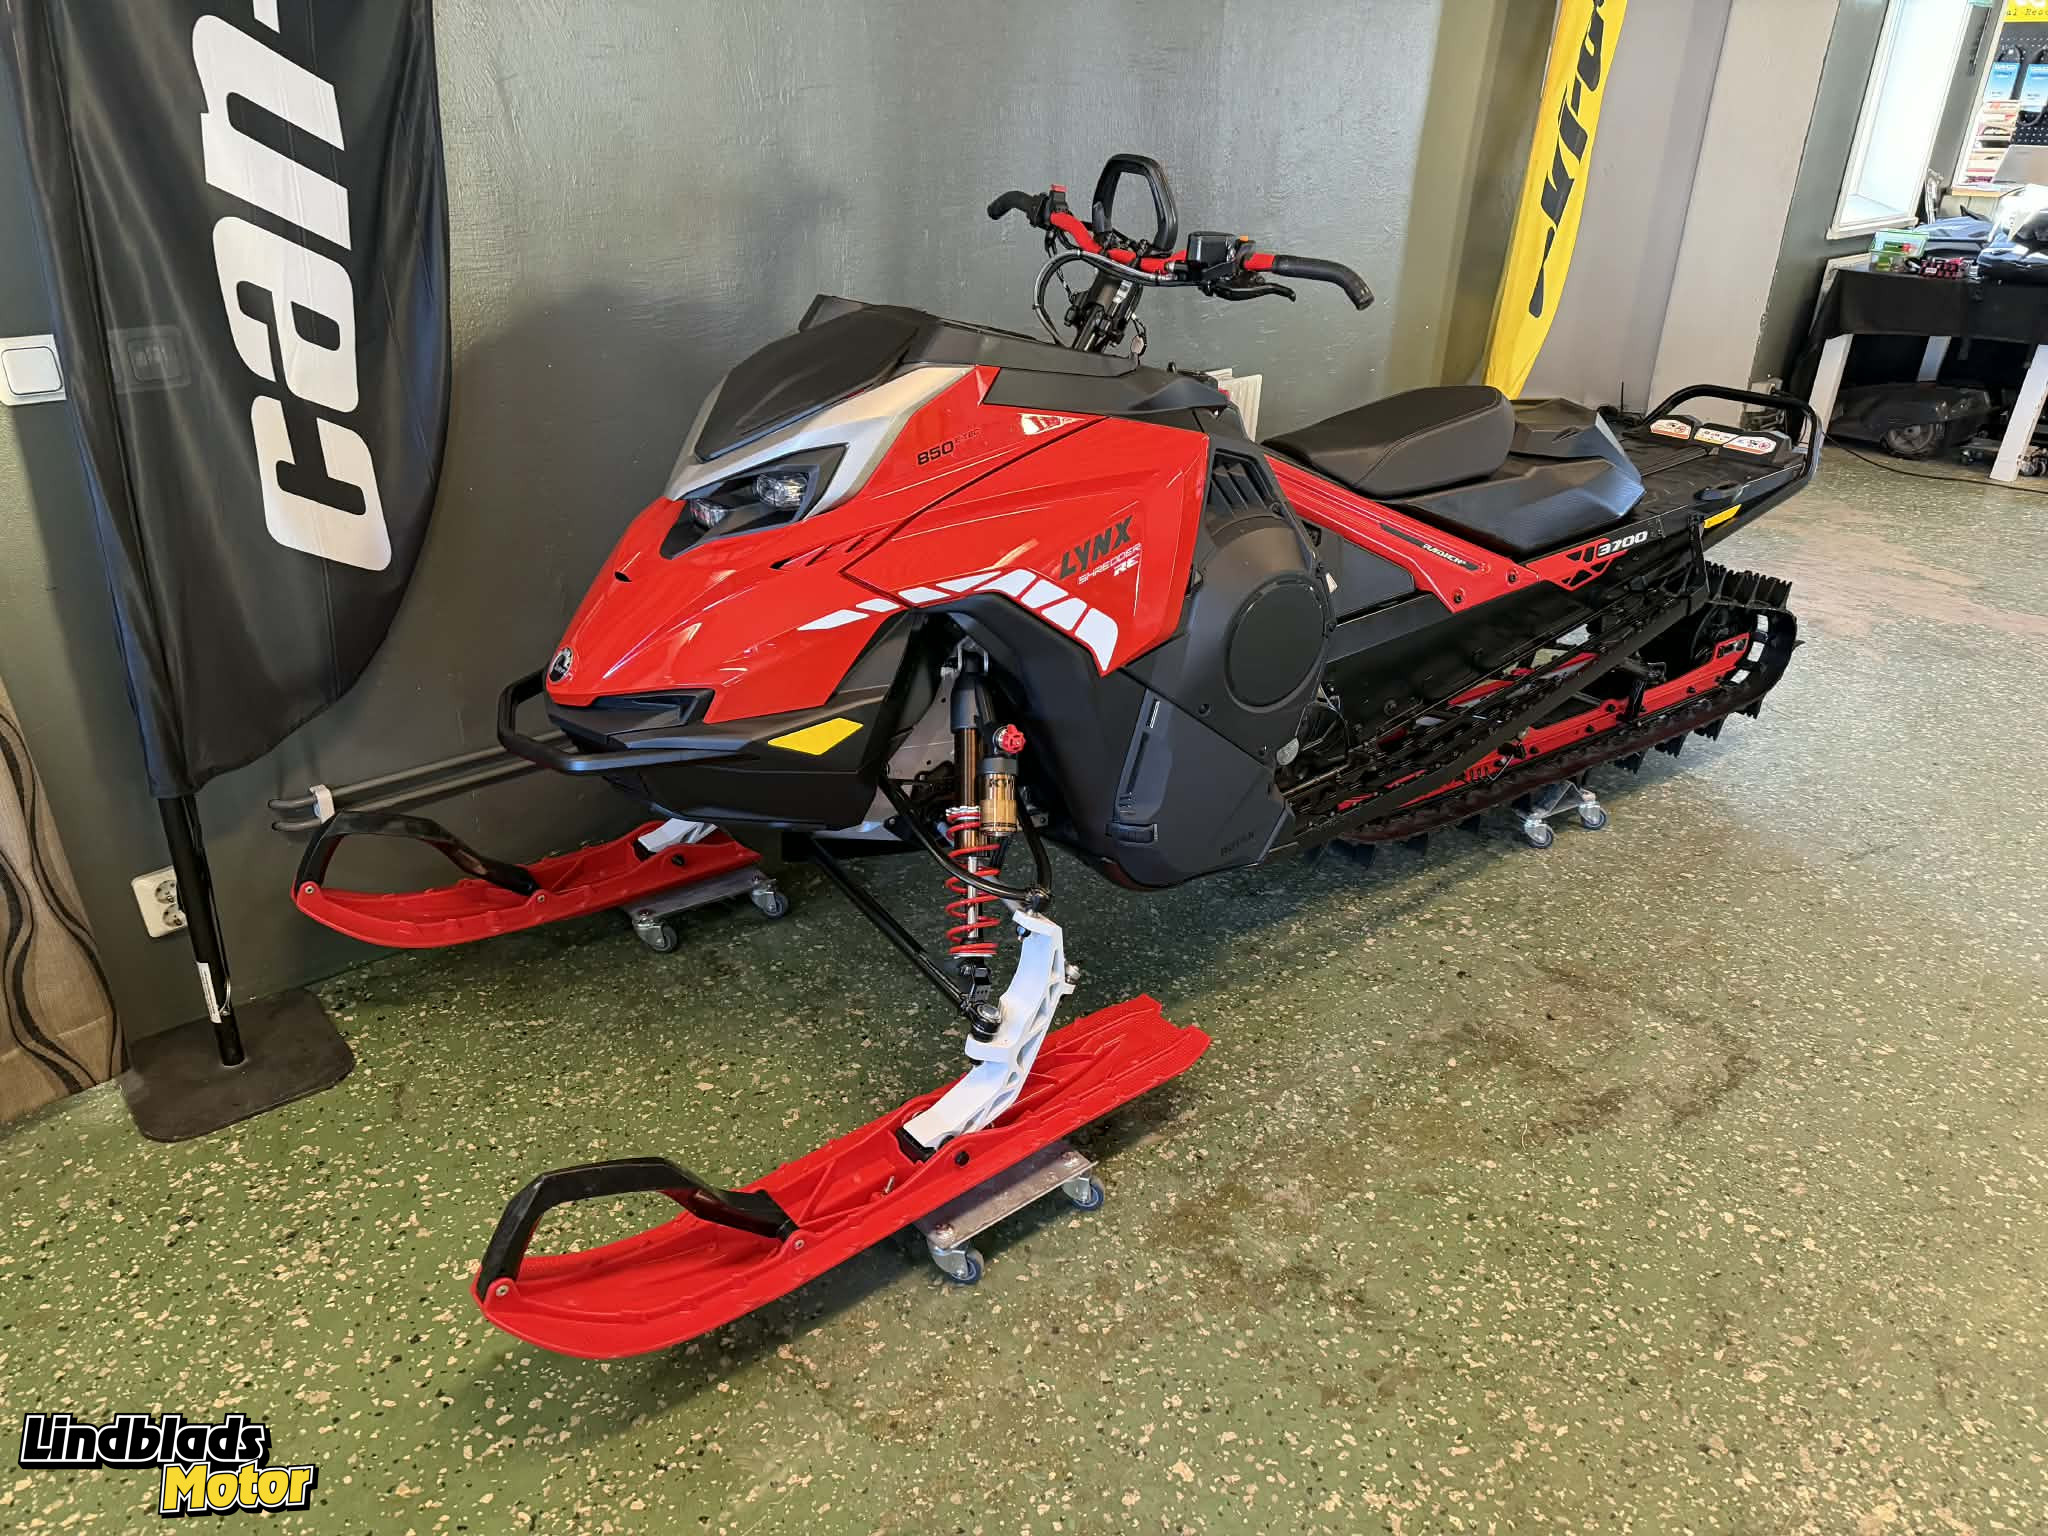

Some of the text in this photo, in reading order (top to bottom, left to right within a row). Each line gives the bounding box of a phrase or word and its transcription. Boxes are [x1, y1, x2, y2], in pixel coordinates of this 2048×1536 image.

[917, 440, 954, 466] 850
[1059, 514, 1133, 580] LYNX
[1597, 530, 1649, 557] 3700
[1078, 543, 1141, 585] SHREDDER
[1114, 553, 1140, 577] RE
